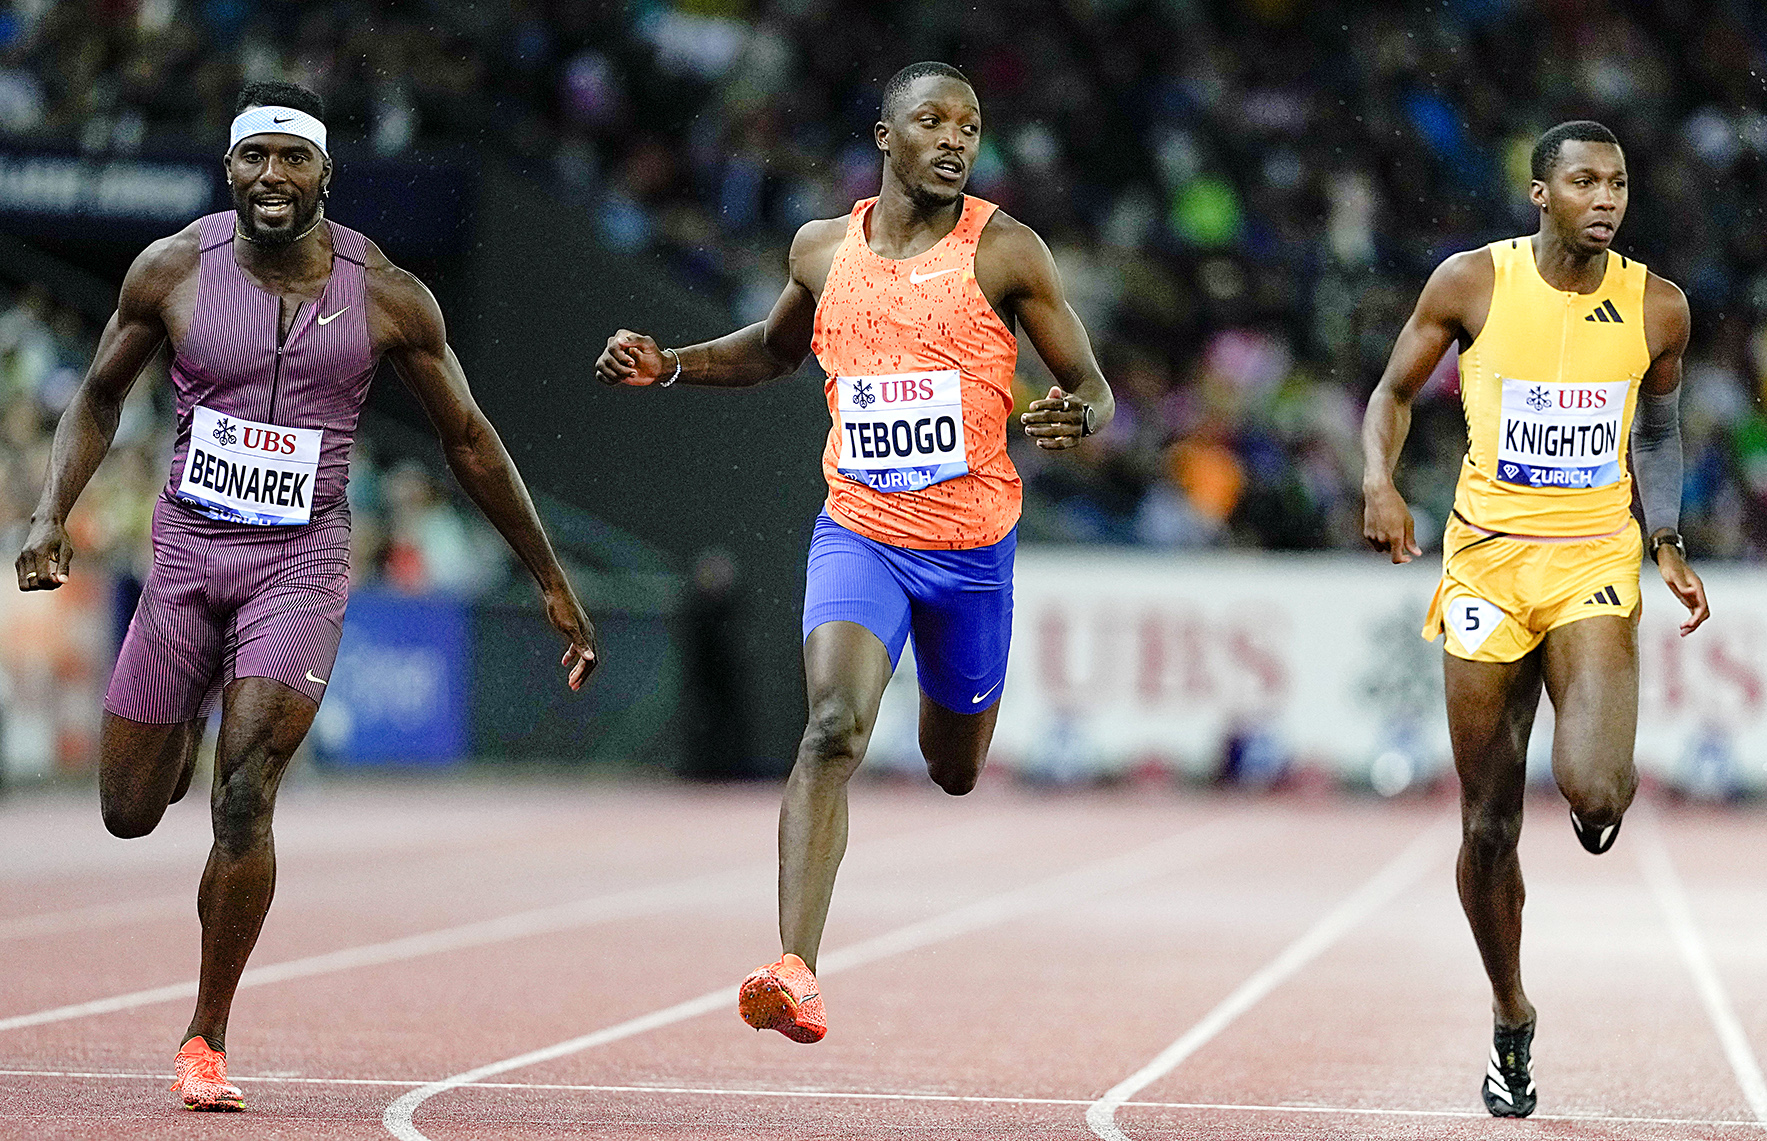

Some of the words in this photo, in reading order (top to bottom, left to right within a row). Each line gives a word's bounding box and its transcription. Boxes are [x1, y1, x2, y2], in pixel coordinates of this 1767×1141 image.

[880, 378, 934, 403] UBS
[1557, 388, 1608, 409] UBS
[243, 426, 297, 455] UBS
[845, 415, 957, 458] TEBOGO
[1505, 418, 1617, 457] KNIGHTON
[188, 448, 310, 508] BEDNAREK
[868, 469, 932, 489] ZURICH
[1529, 467, 1593, 485] ZURICH
[1465, 606, 1480, 631] 5
